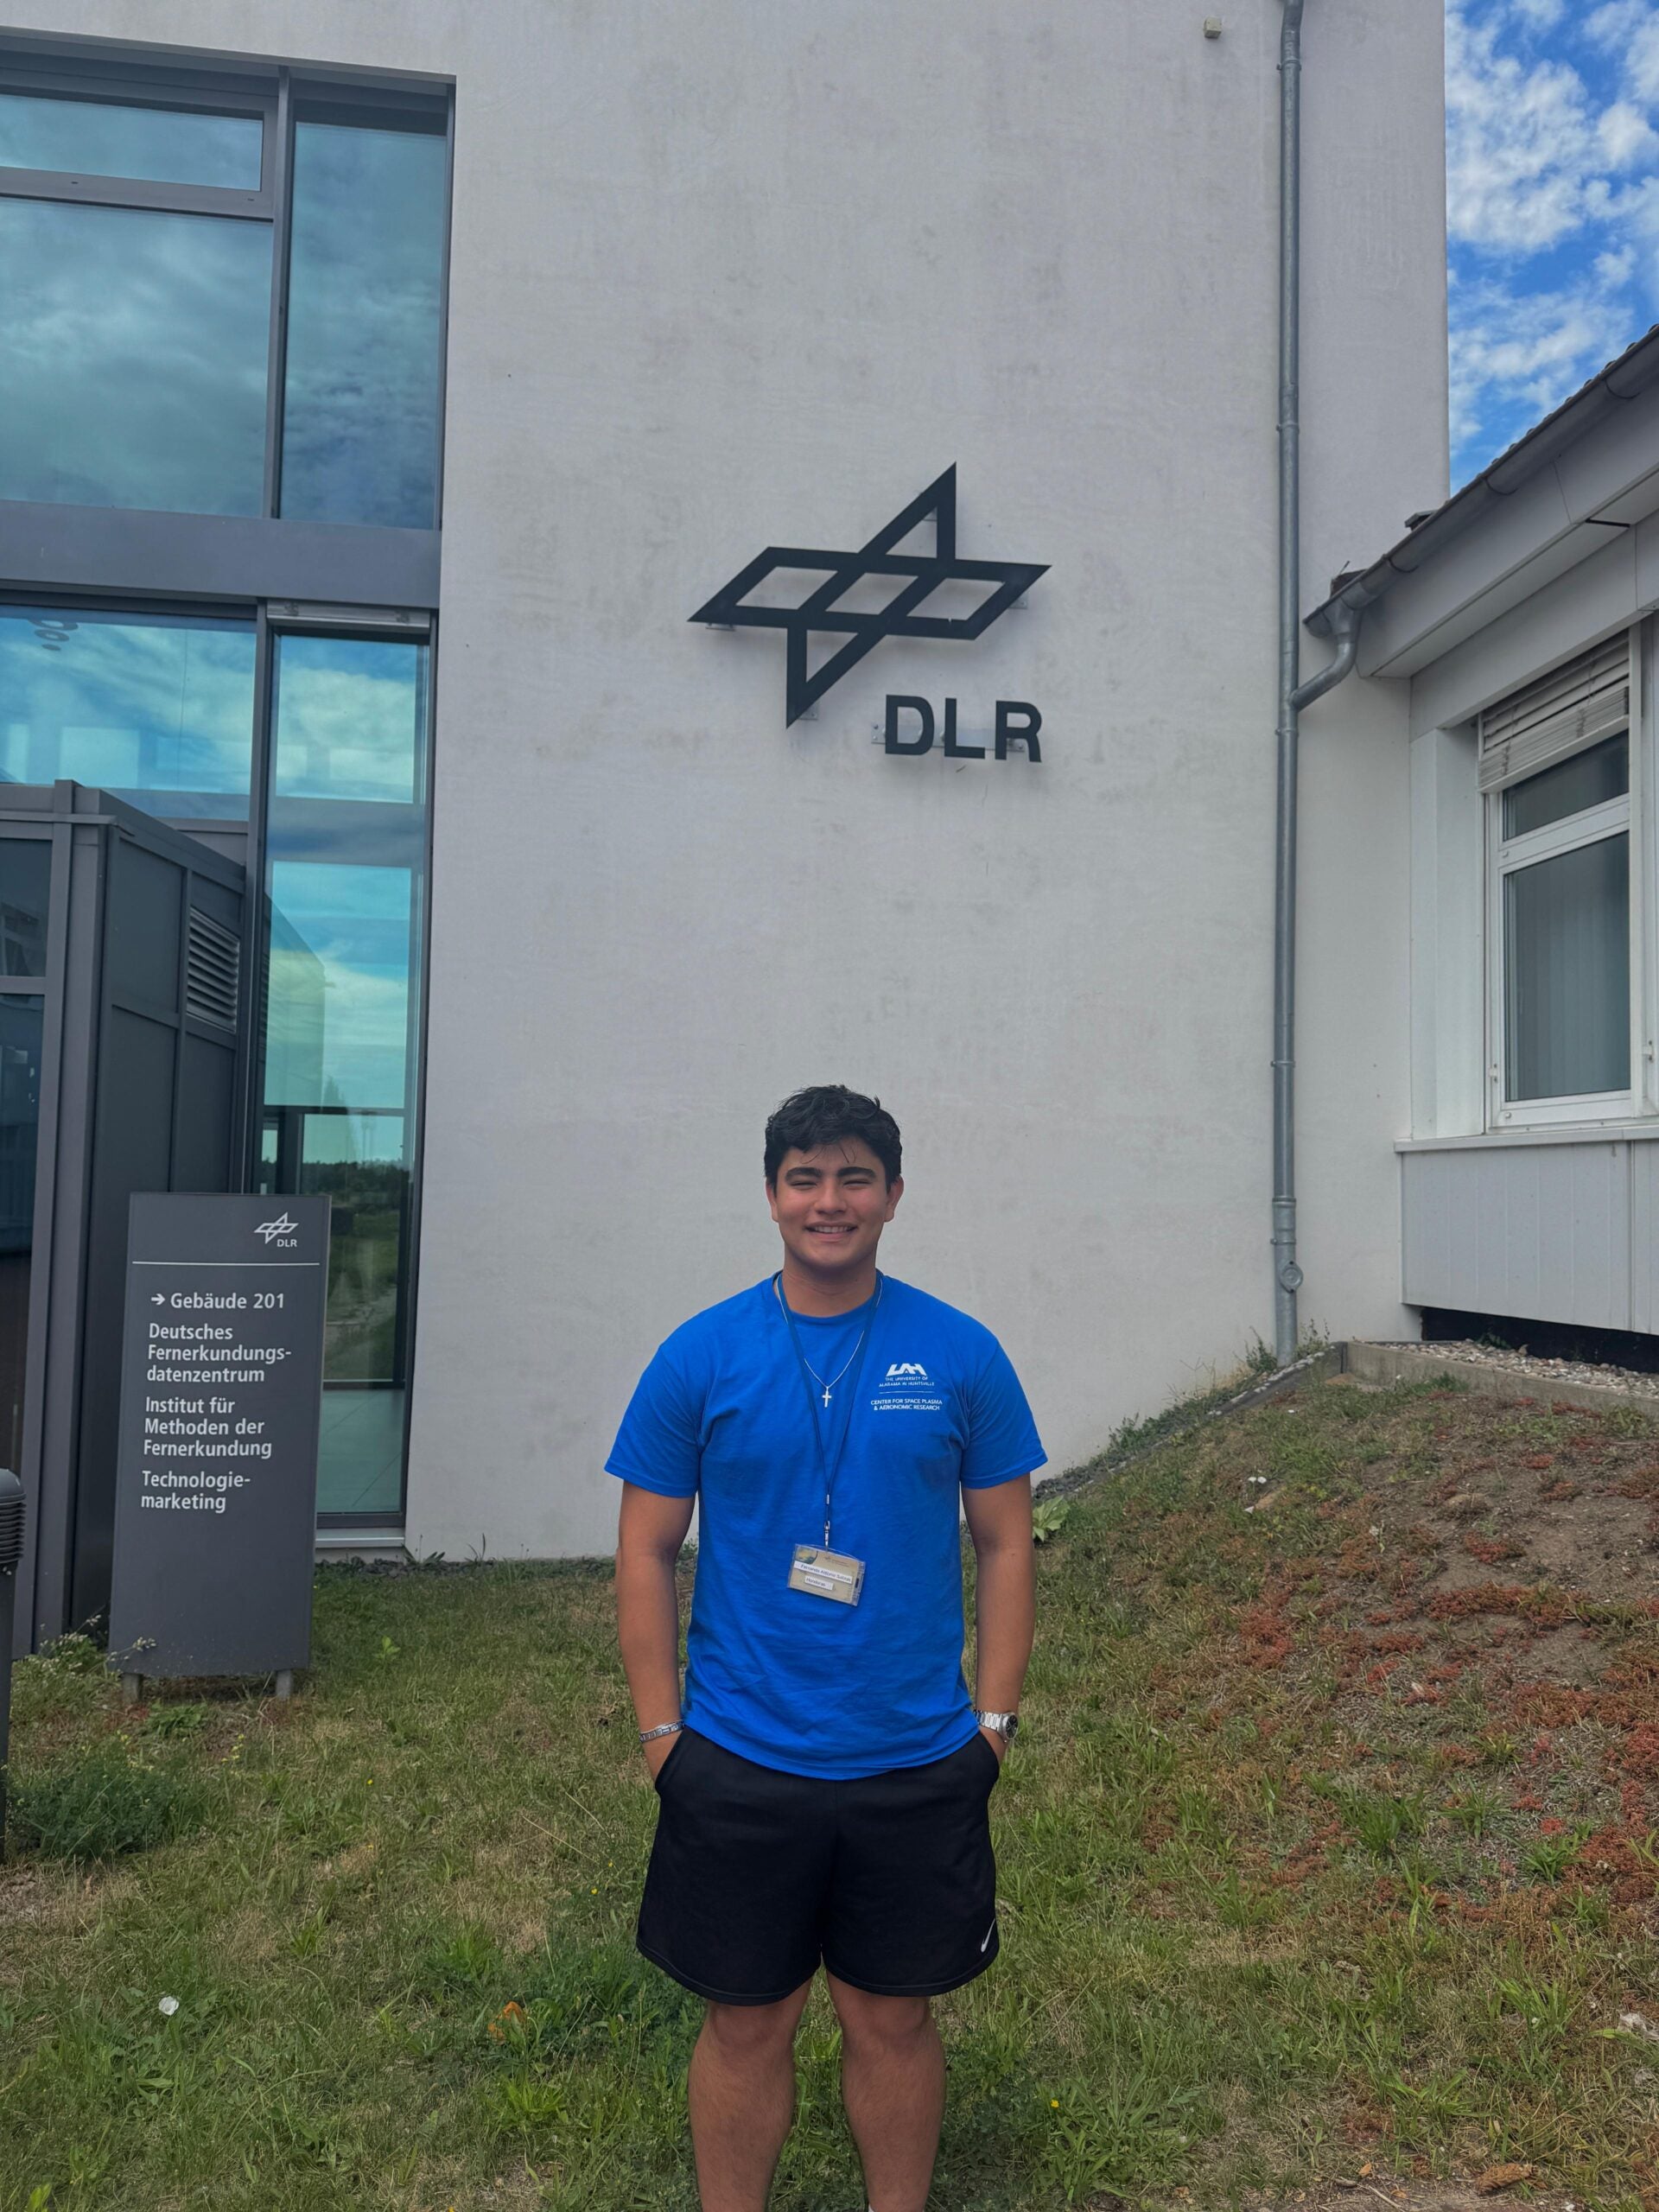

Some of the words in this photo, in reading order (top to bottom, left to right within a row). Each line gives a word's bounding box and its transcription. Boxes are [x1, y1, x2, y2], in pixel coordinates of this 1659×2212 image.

[885, 694, 1043, 763] DLR
[276, 1238, 298, 1248] DLR
[170, 1292, 247, 1309] Gebäude
[252, 1293, 284, 1309] 201
[149, 1323, 233, 1340] Deutsches
[148, 1344, 291, 1364] Fernerkundungs-
[147, 1365, 265, 1382] datenzentrum
[886, 1363, 927, 1376] UAH
[145, 1396, 204, 1414] Institut
[209, 1397, 235, 1414] für
[144, 1418, 229, 1434] Methoden
[235, 1418, 265, 1434] der
[143, 1440, 272, 1459] Fernerkundung
[142, 1471, 251, 1492] Technologie-
[141, 1493, 226, 1513] marketing
